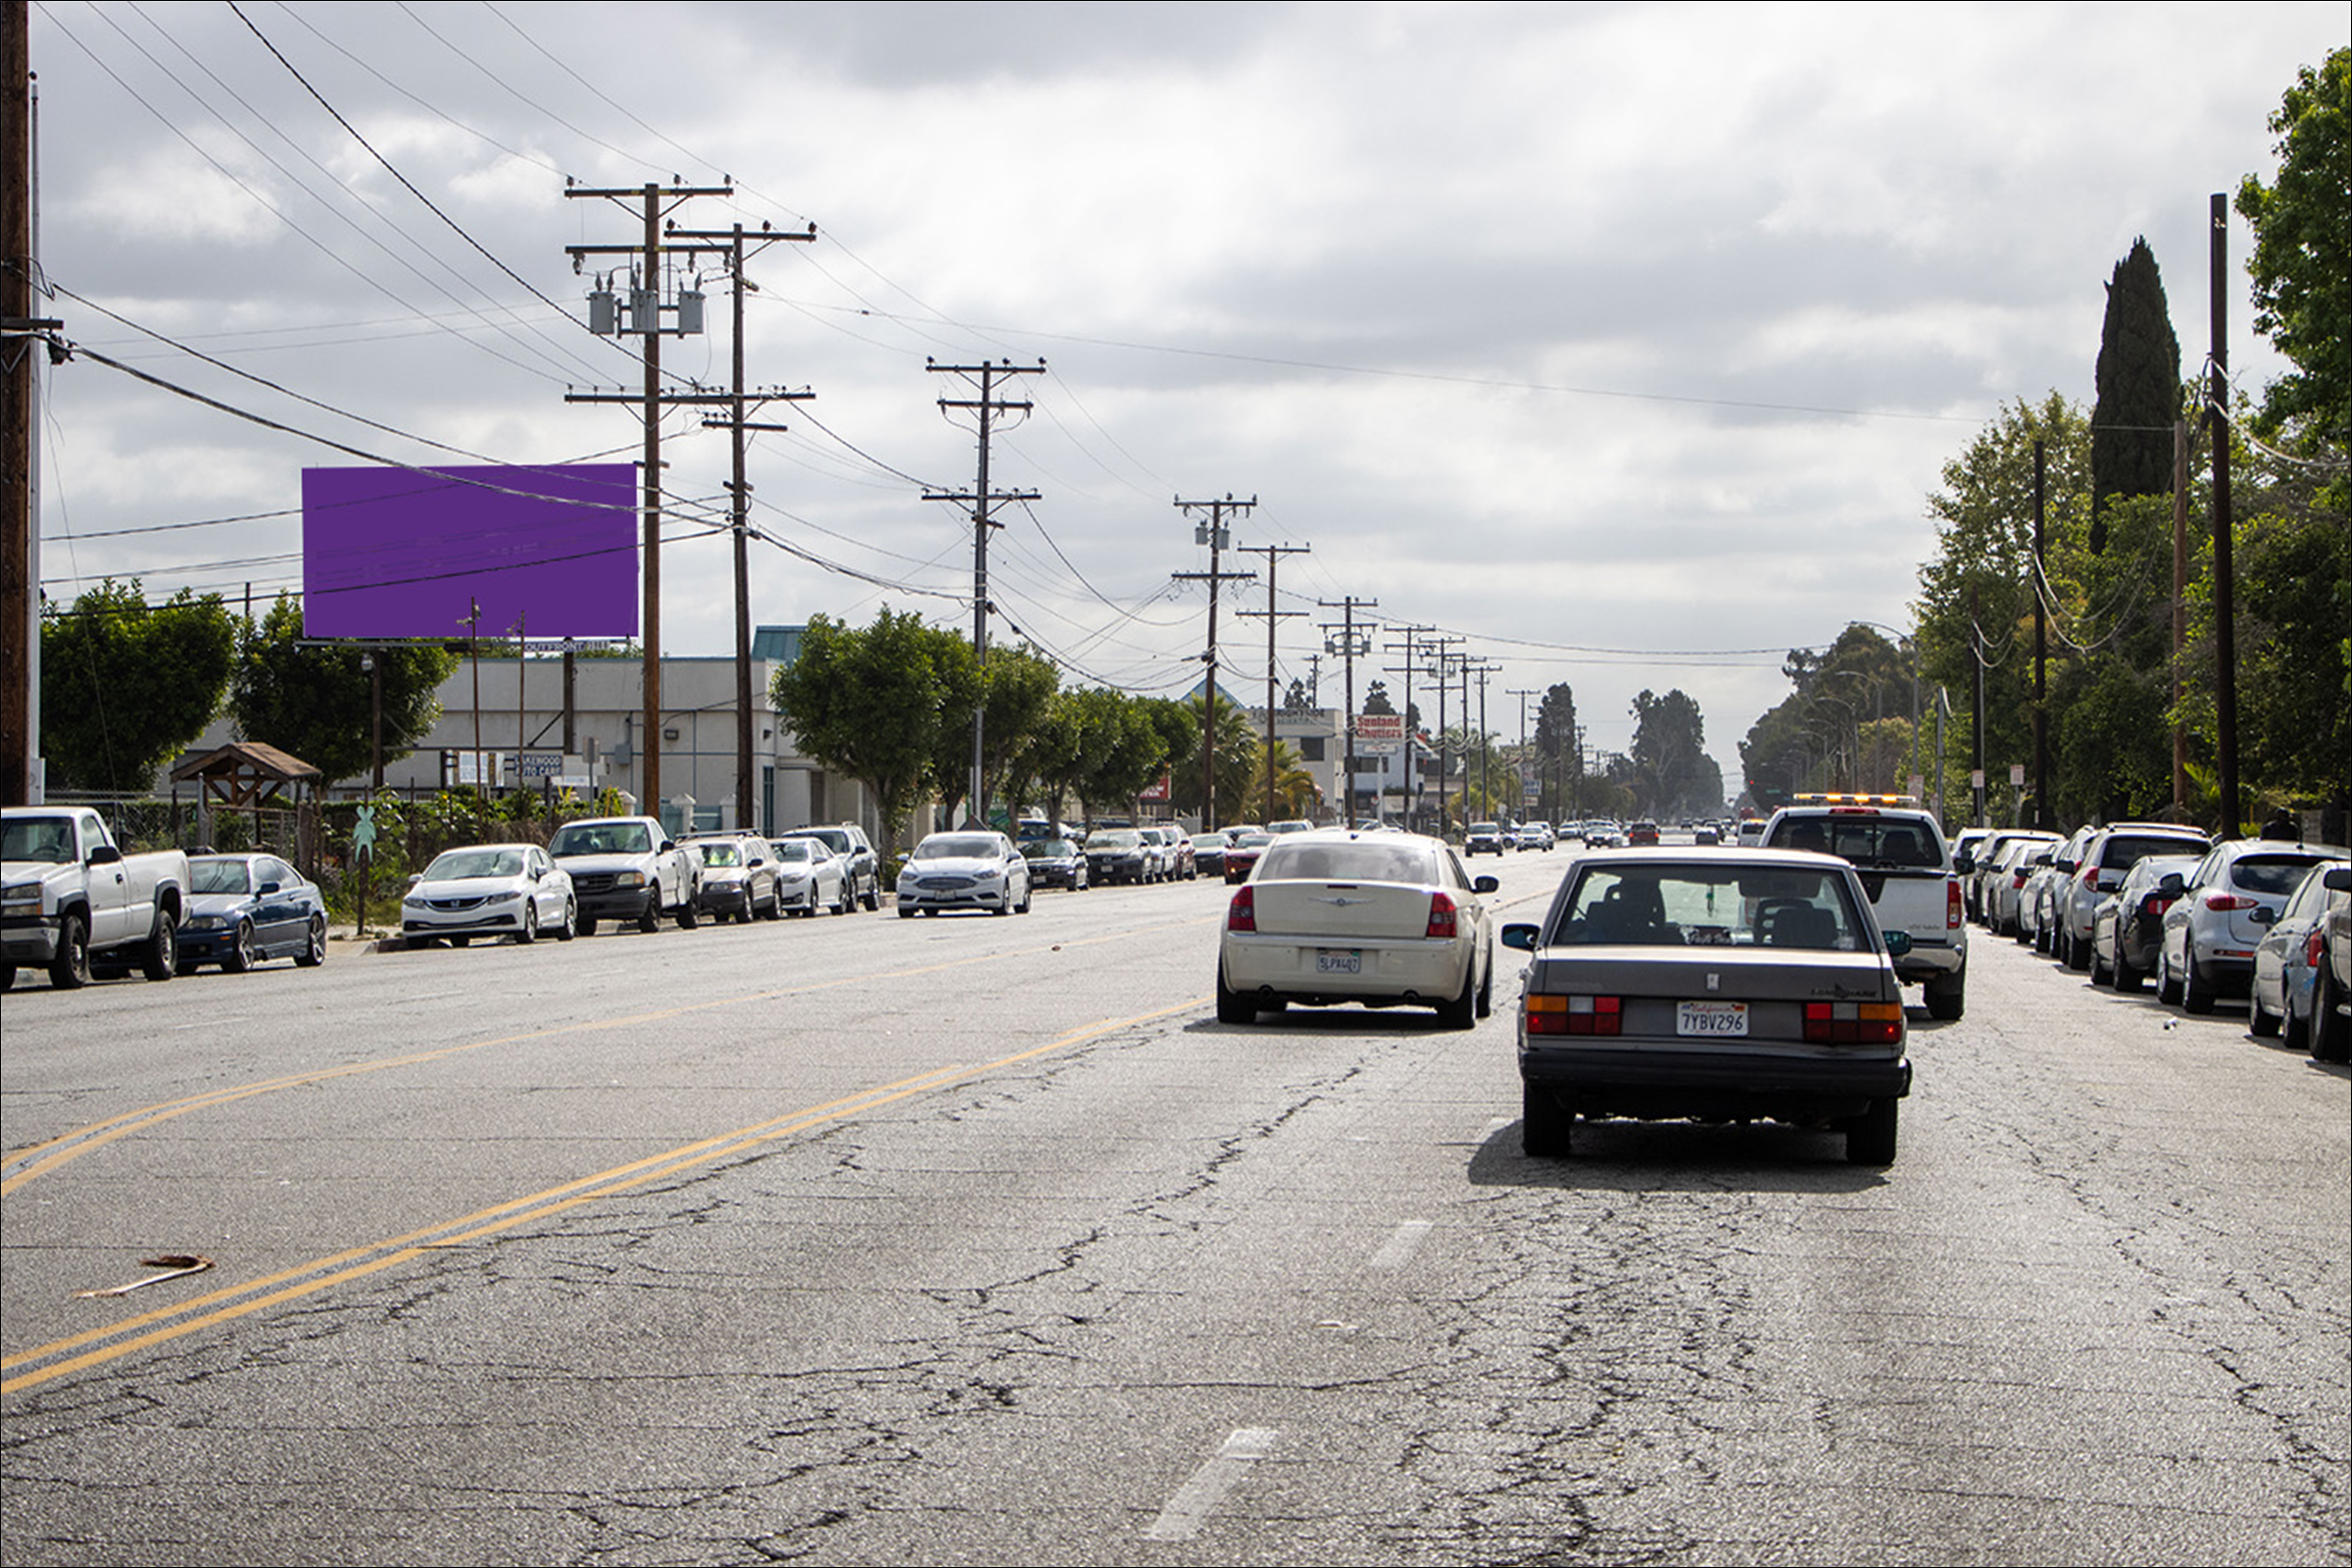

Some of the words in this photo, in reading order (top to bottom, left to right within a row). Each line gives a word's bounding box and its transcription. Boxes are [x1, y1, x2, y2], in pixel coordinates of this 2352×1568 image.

[525, 642, 585, 652] OUTFRONT
[1357, 716, 1400, 727] Sunland
[1682, 1013, 1743, 1031] 7YBV296
